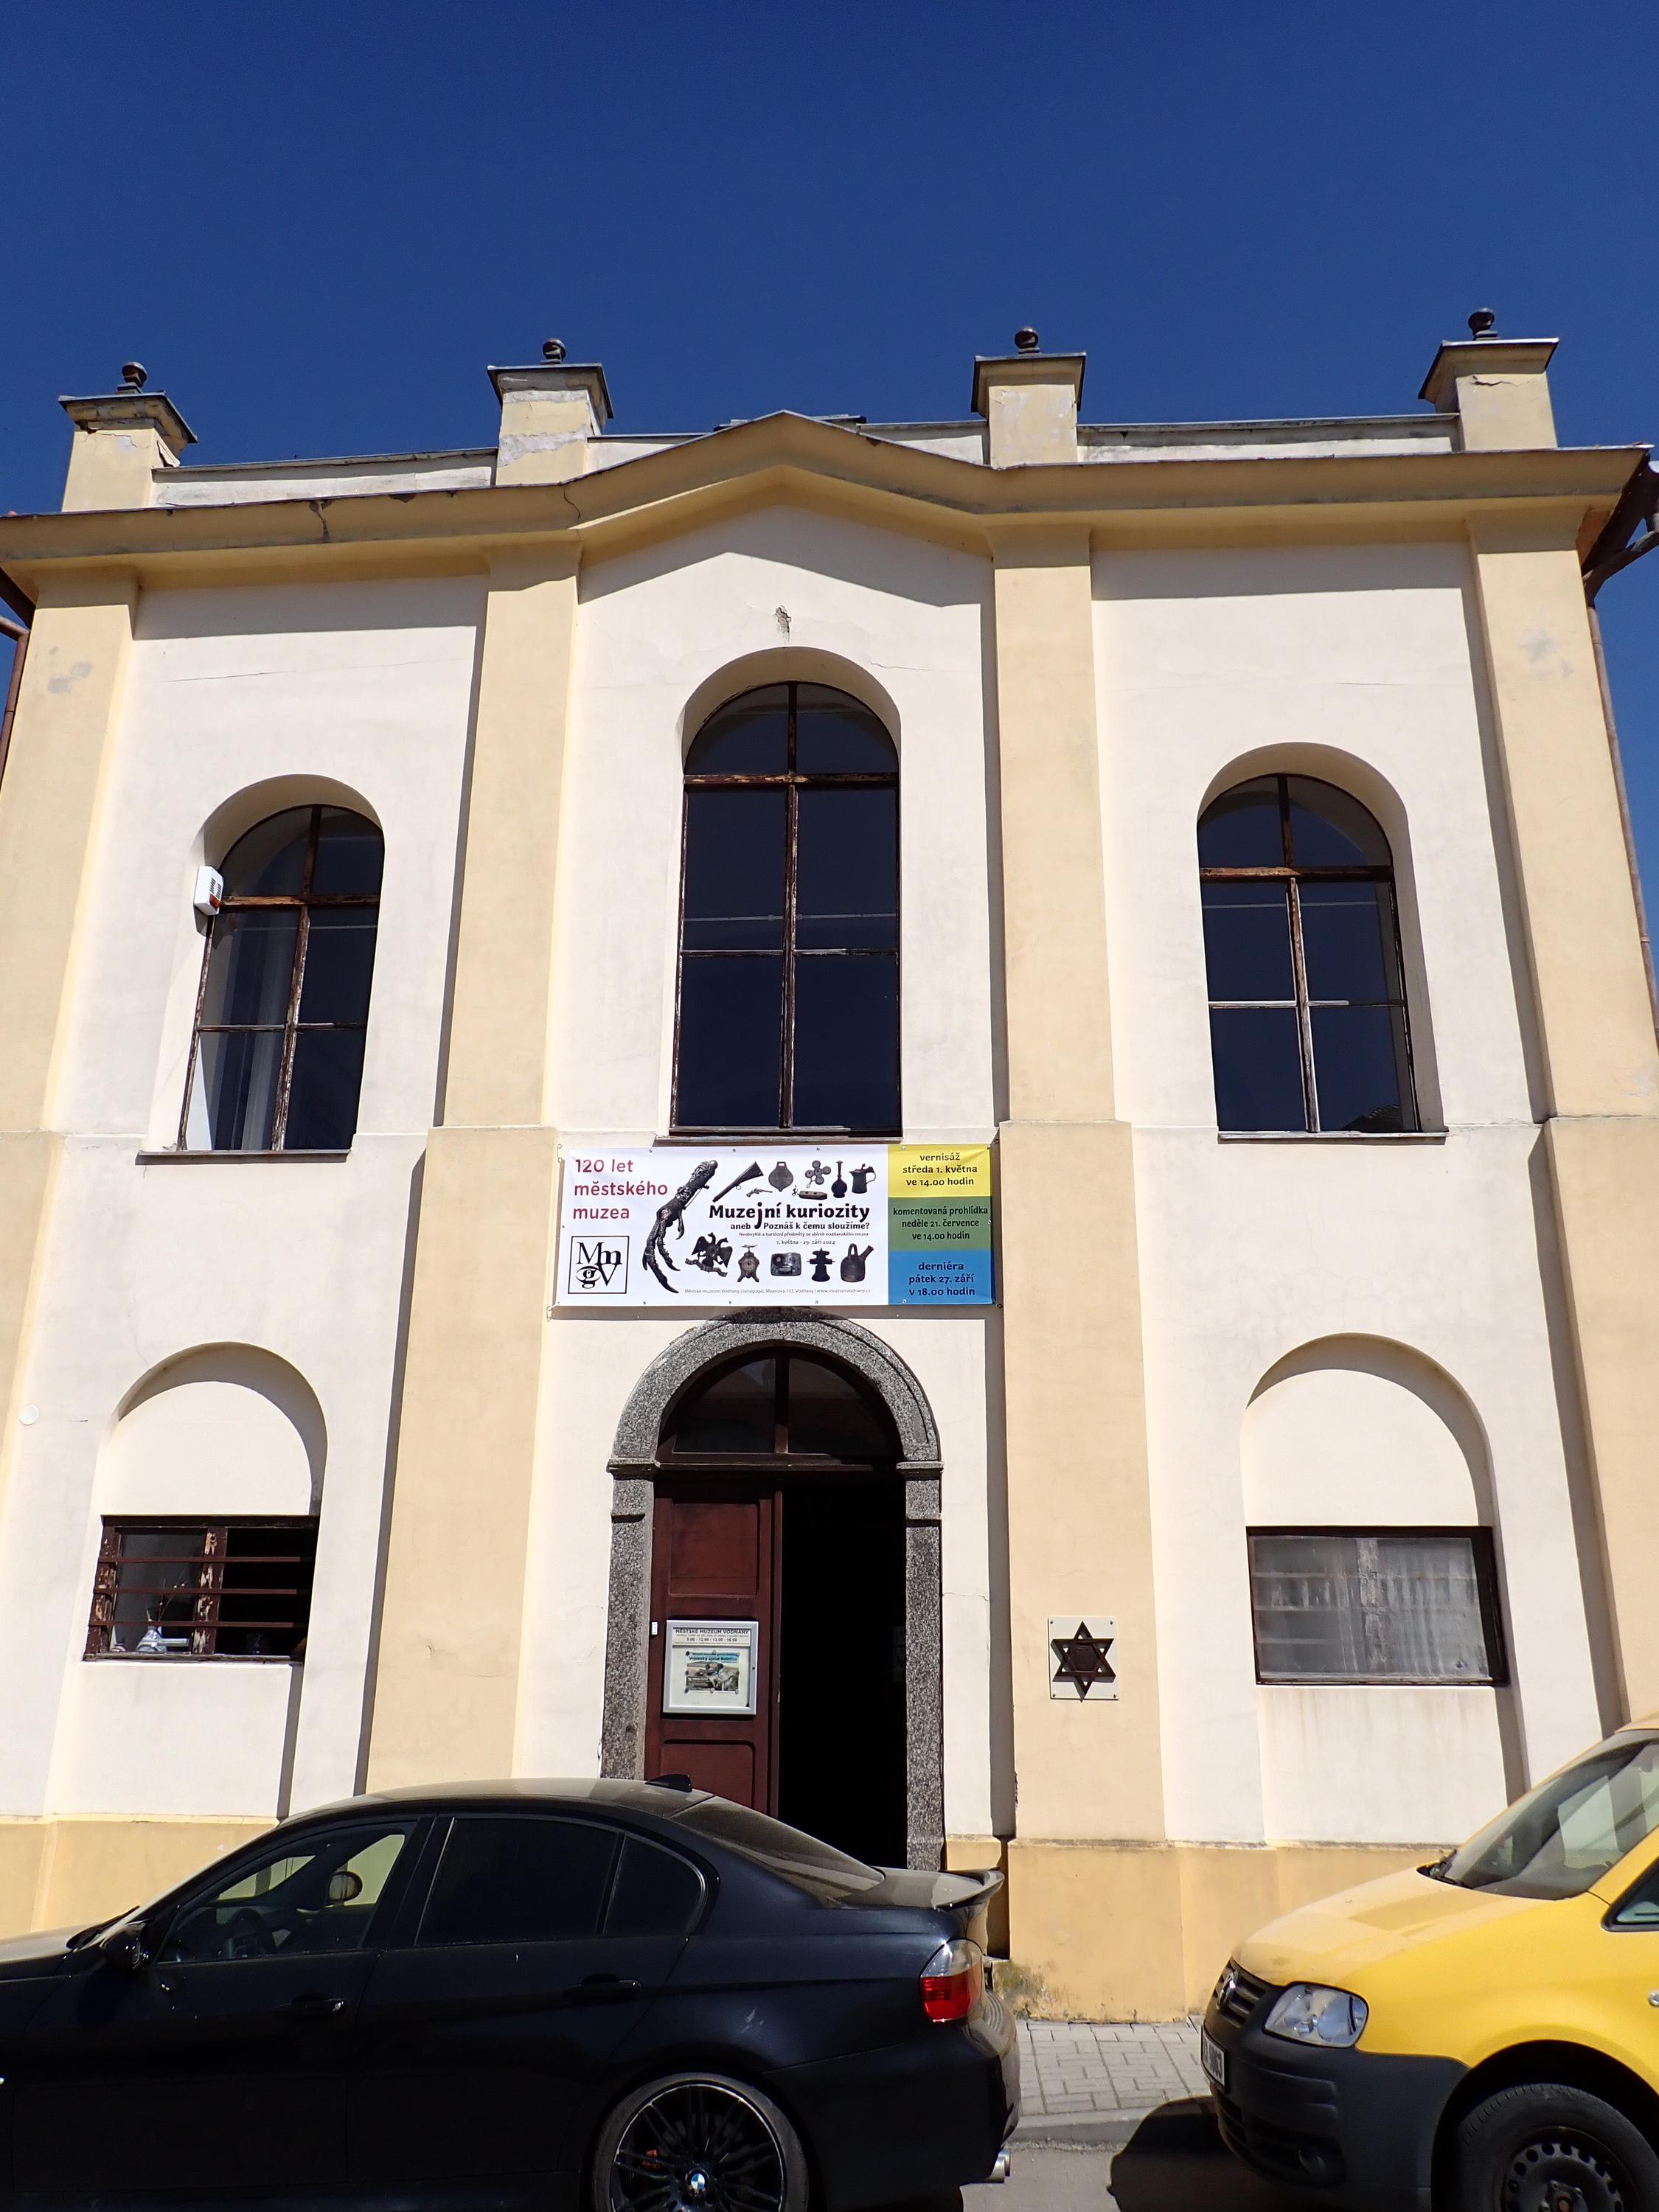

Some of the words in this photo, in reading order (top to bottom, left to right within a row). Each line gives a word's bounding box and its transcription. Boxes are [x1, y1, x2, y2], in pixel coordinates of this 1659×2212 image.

[919, 1152, 961, 1161] vernisáž
[576, 1159, 604, 1172] 120
[612, 1159, 633, 1172] let
[902, 1165, 933, 1173] středa
[946, 1165, 977, 1173] května
[947, 1178, 974, 1186] hodin
[574, 1181, 668, 1196] městského
[573, 1208, 630, 1219] muzea
[709, 1202, 782, 1229] Muzejní
[786, 1203, 870, 1222] kuriozity
[893, 1206, 947, 1215] komentovaná
[950, 1206, 988, 1217] prohlídka
[763, 1222, 793, 1230] Poznáš
[803, 1222, 826, 1230] čemu
[827, 1221, 870, 1230] sloužíme?
[943, 1219, 979, 1227] července
[923, 1233, 945, 1241] 14.00
[919, 1262, 964, 1270] derniéra
[908, 1275, 936, 1285] pátek
[939, 1276, 952, 1284] 27.
[955, 1274, 974, 1283] září
[917, 1287, 944, 1295] 18.00
[947, 1287, 975, 1295] hodin
